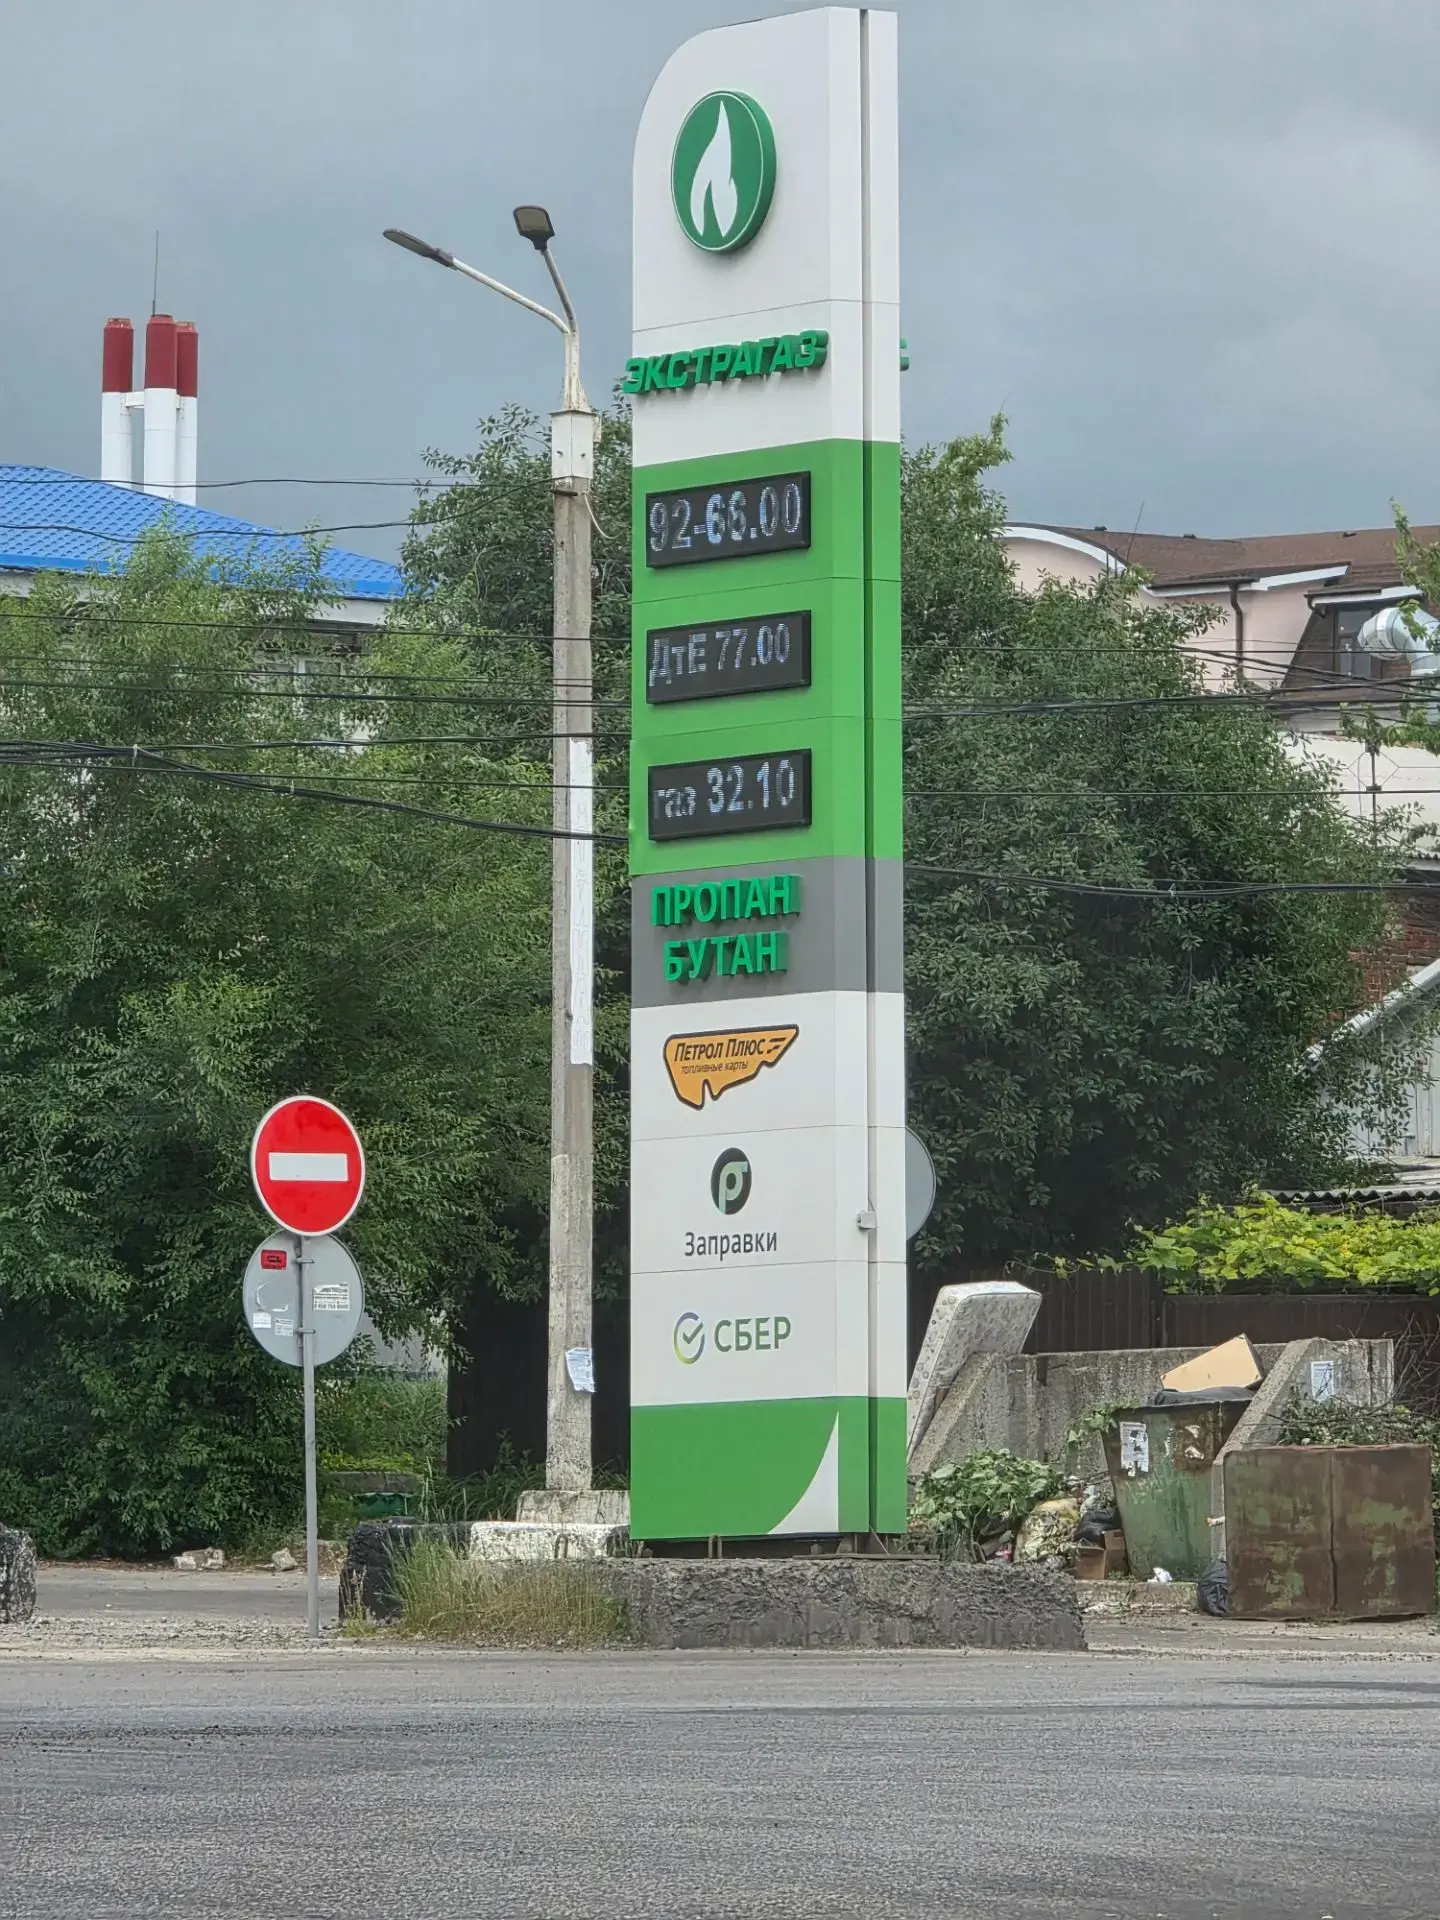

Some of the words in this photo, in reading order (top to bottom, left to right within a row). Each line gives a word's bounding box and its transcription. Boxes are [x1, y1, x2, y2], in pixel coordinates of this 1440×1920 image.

[623, 329, 829, 394] ЭКСТРАГАЗ
[715, 623, 790, 670] 77.00
[706, 759, 796, 813] 32.10
[651, 875, 802, 927] ПРОПАН
[663, 931, 788, 982] БУТАН
[684, 1232, 777, 1261] Заправки
[714, 1316, 792, 1352] СБЕР
